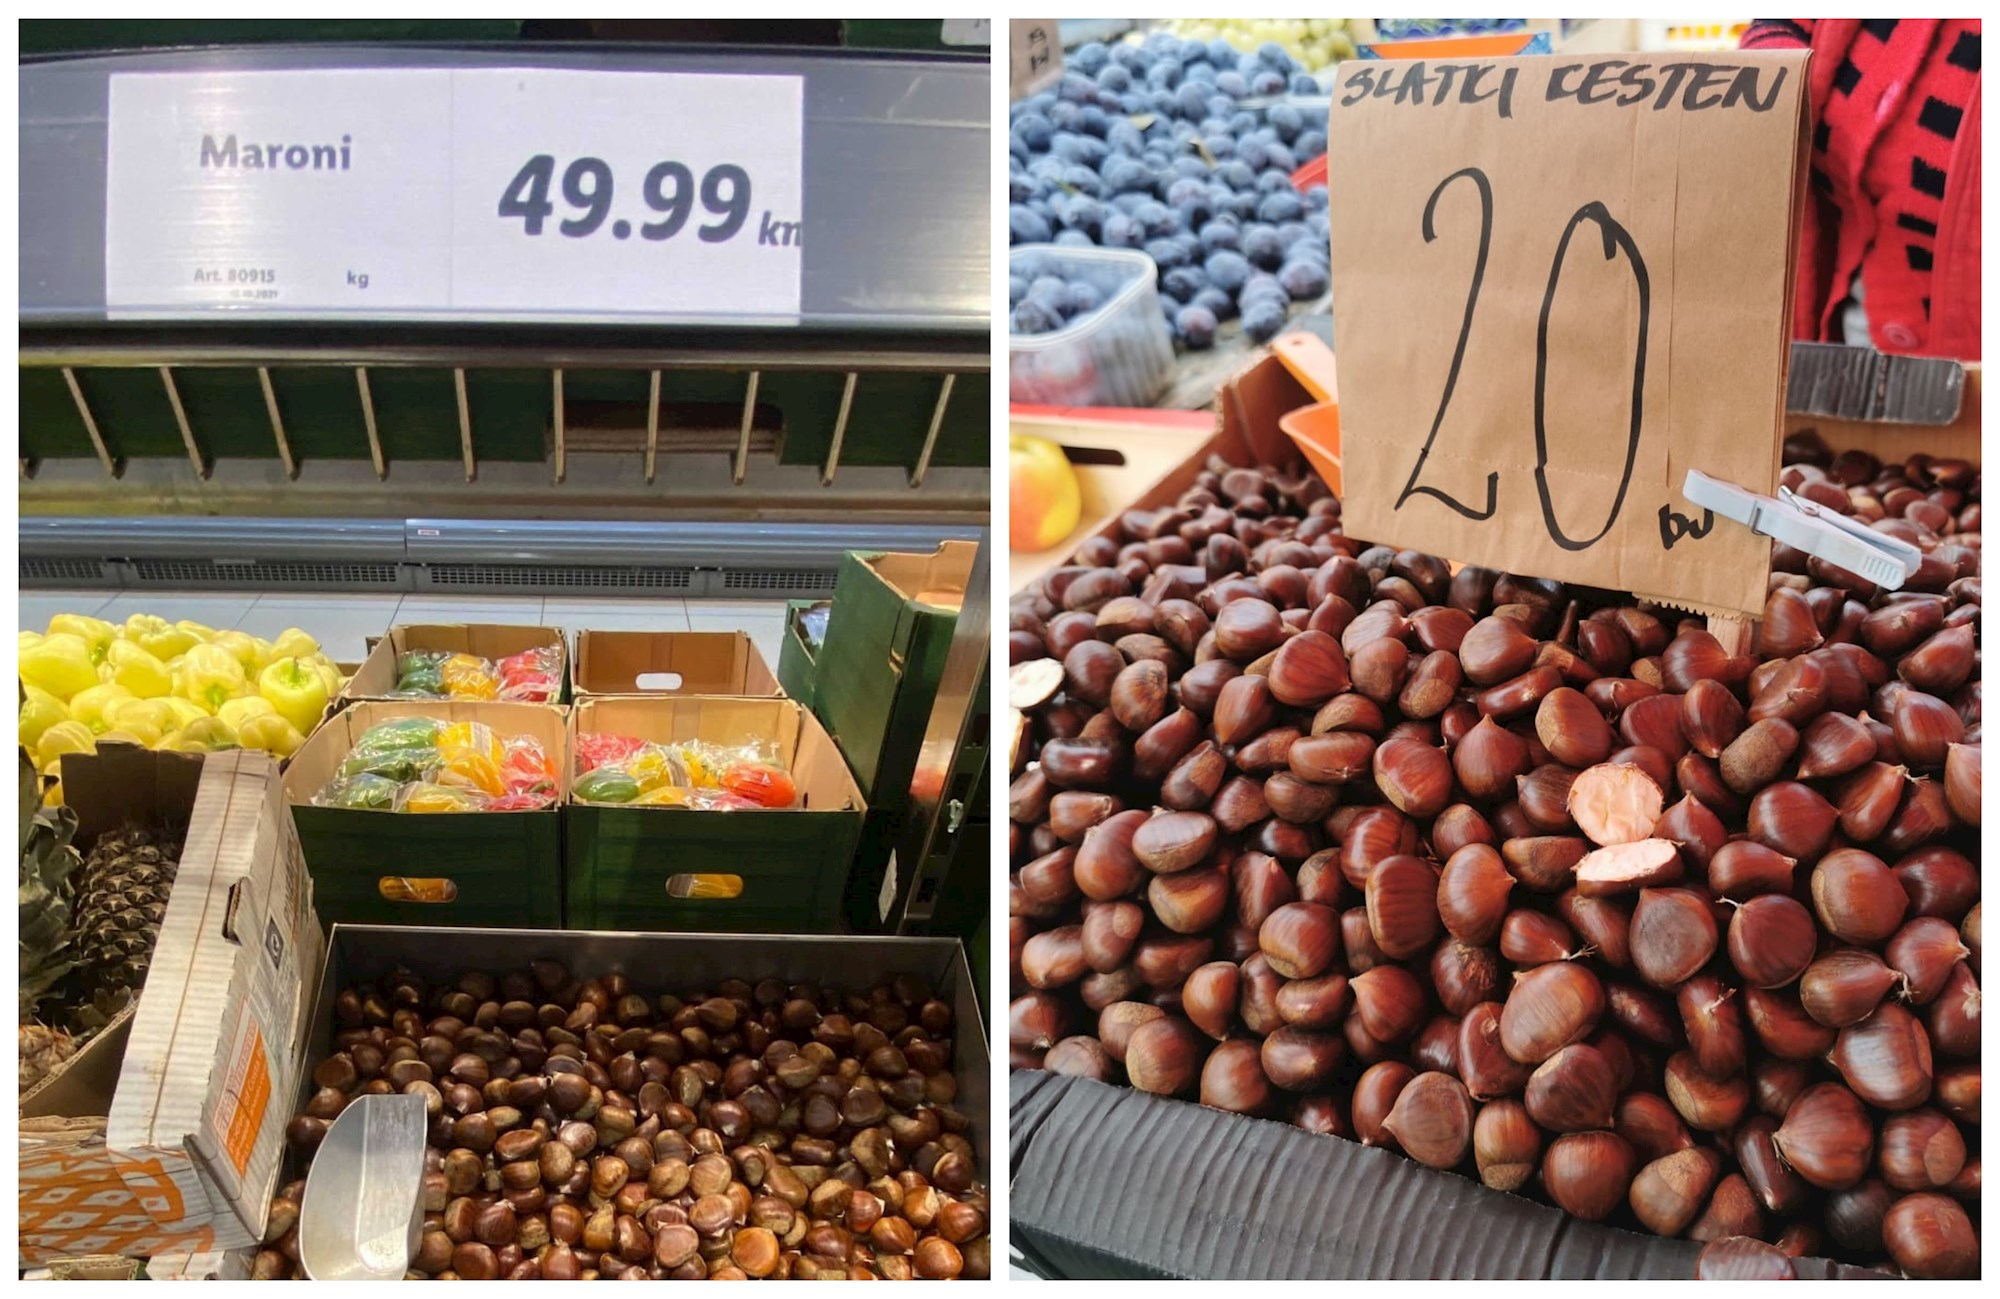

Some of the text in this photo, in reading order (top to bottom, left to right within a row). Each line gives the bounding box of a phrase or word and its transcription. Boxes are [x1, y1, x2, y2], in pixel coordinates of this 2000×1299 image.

[200, 134, 352, 171] Maroni
[497, 154, 802, 247] 49.99 kn
[194, 268, 276, 284] Art. 80915
[346, 269, 370, 290] kg
[1394, 167, 1650, 551] 20
